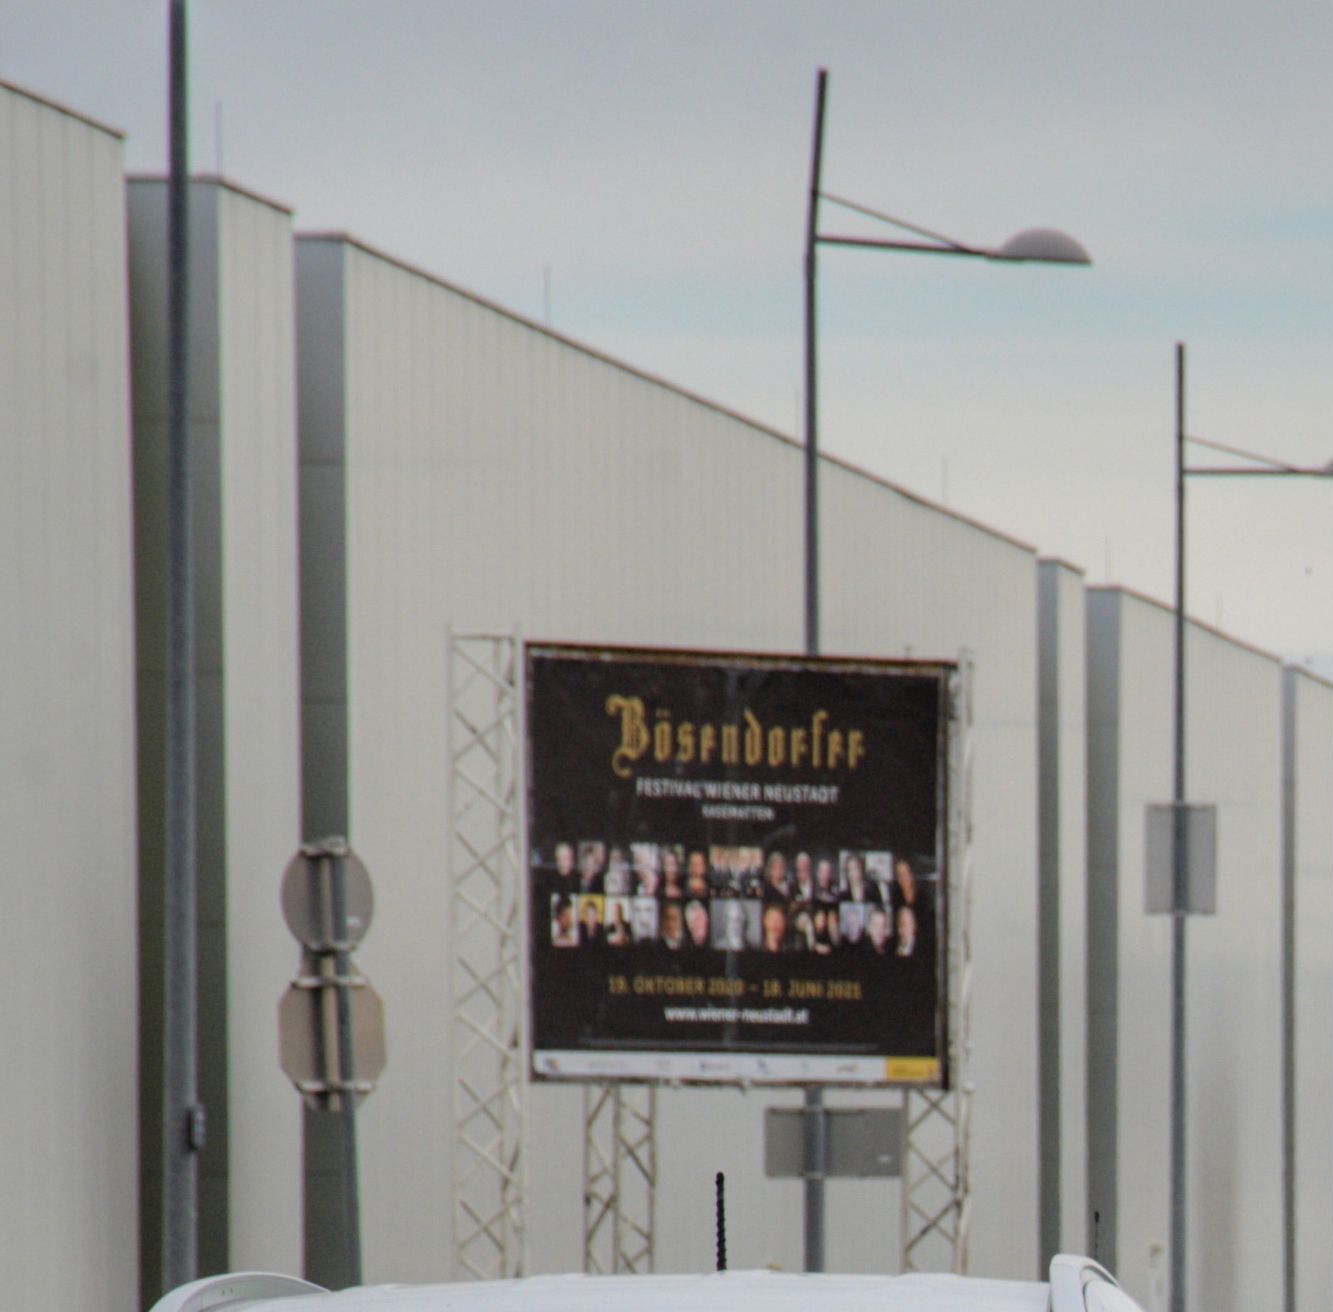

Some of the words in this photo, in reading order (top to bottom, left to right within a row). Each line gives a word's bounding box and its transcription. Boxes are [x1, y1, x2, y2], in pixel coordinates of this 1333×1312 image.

[606, 694, 866, 778] Bösendorfer
[636, 776, 703, 798] FESTIVAL
[704, 781, 762, 801] WIENER
[763, 783, 839, 804] NEUSTADT
[633, 975, 705, 996] OKTOBER
[788, 979, 823, 998] JUNI
